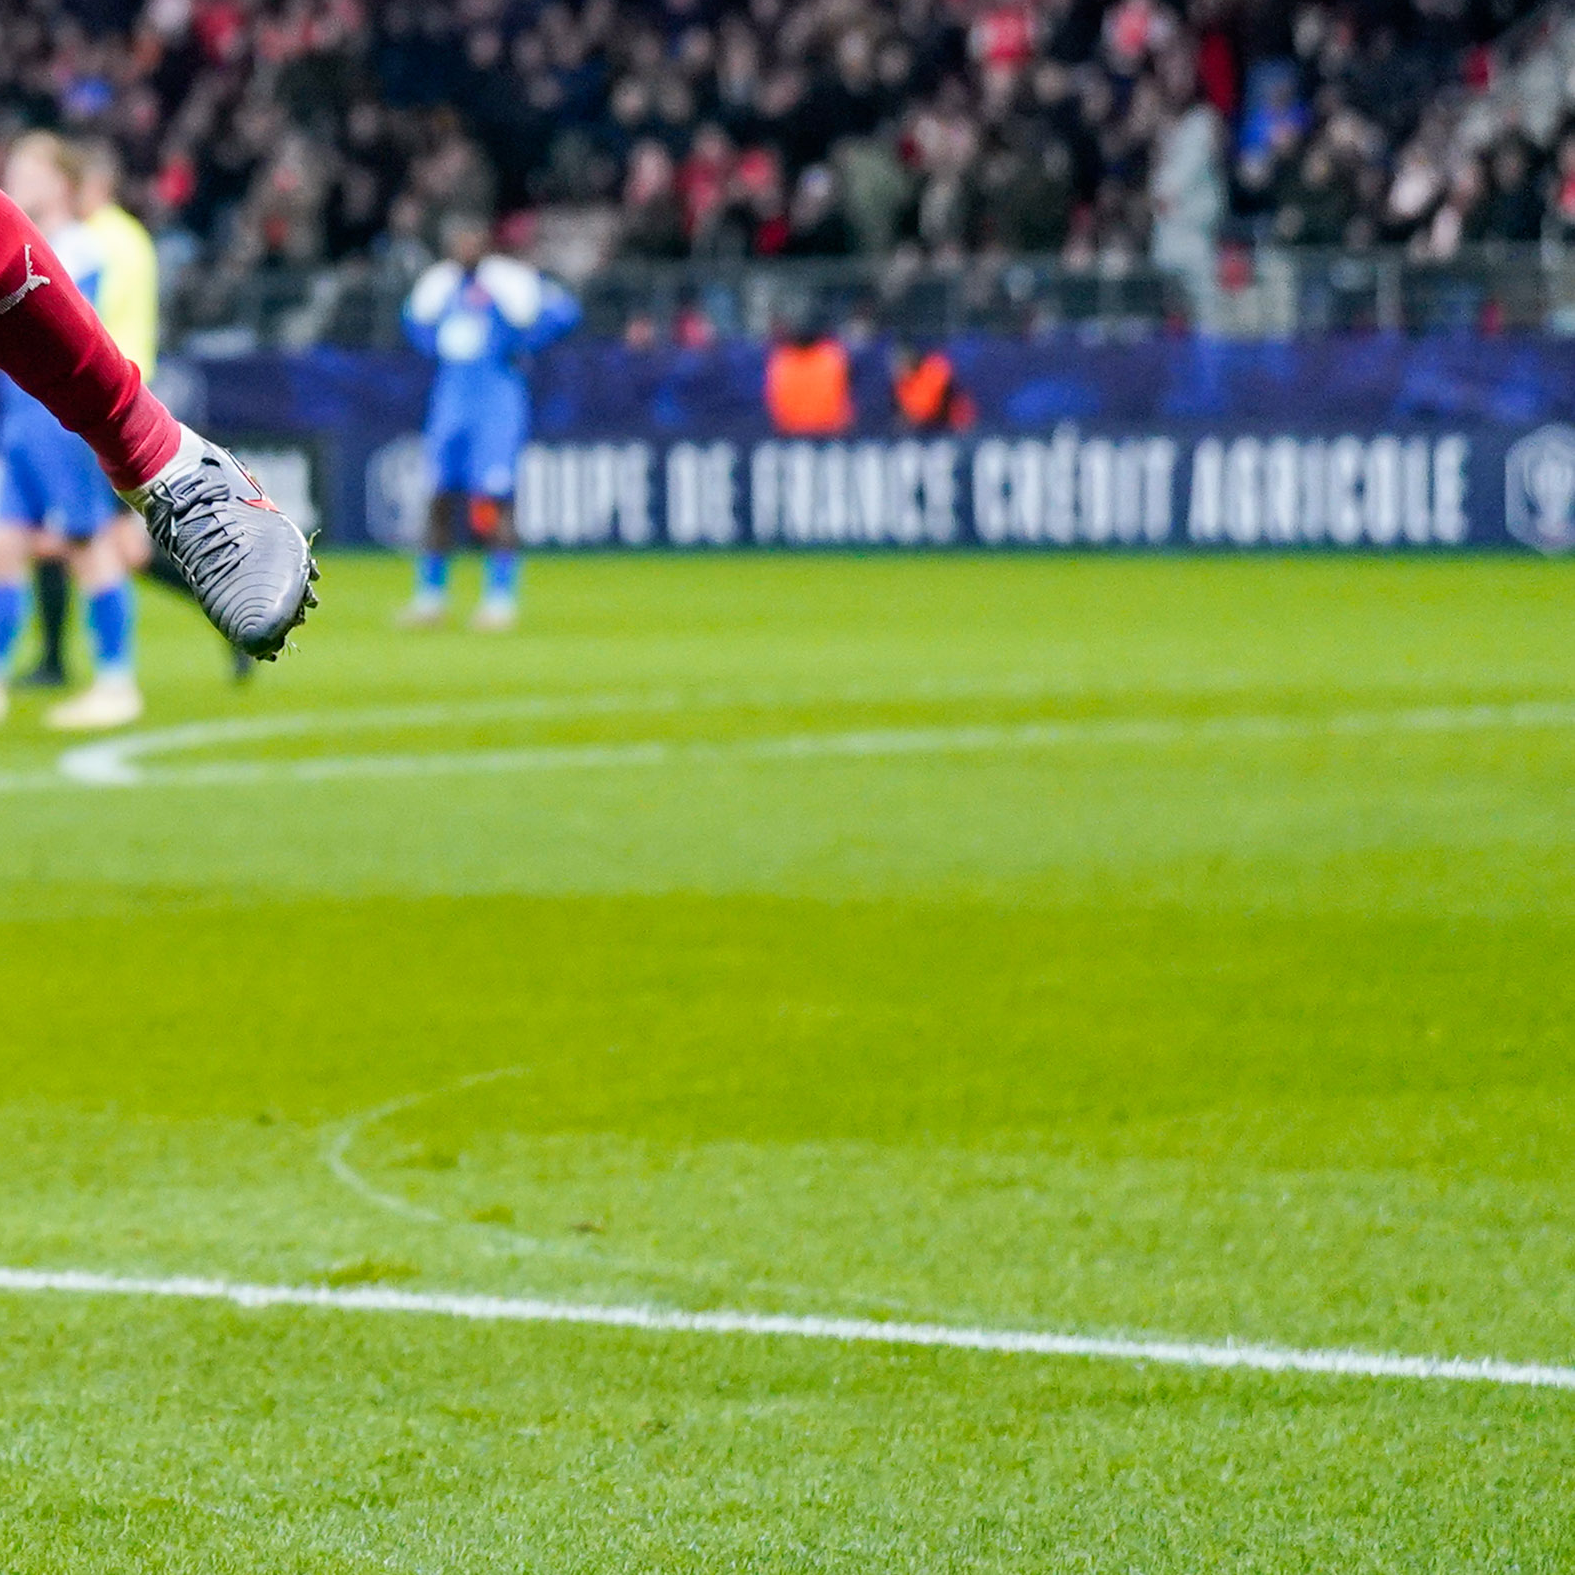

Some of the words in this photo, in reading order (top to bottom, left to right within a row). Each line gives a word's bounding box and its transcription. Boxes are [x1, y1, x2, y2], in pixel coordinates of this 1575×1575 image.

[515, 440, 651, 546] OUPE
[664, 439, 737, 546] DE
[752, 439, 957, 546] FRANCE
[1187, 436, 1469, 546] AGRICOLE
